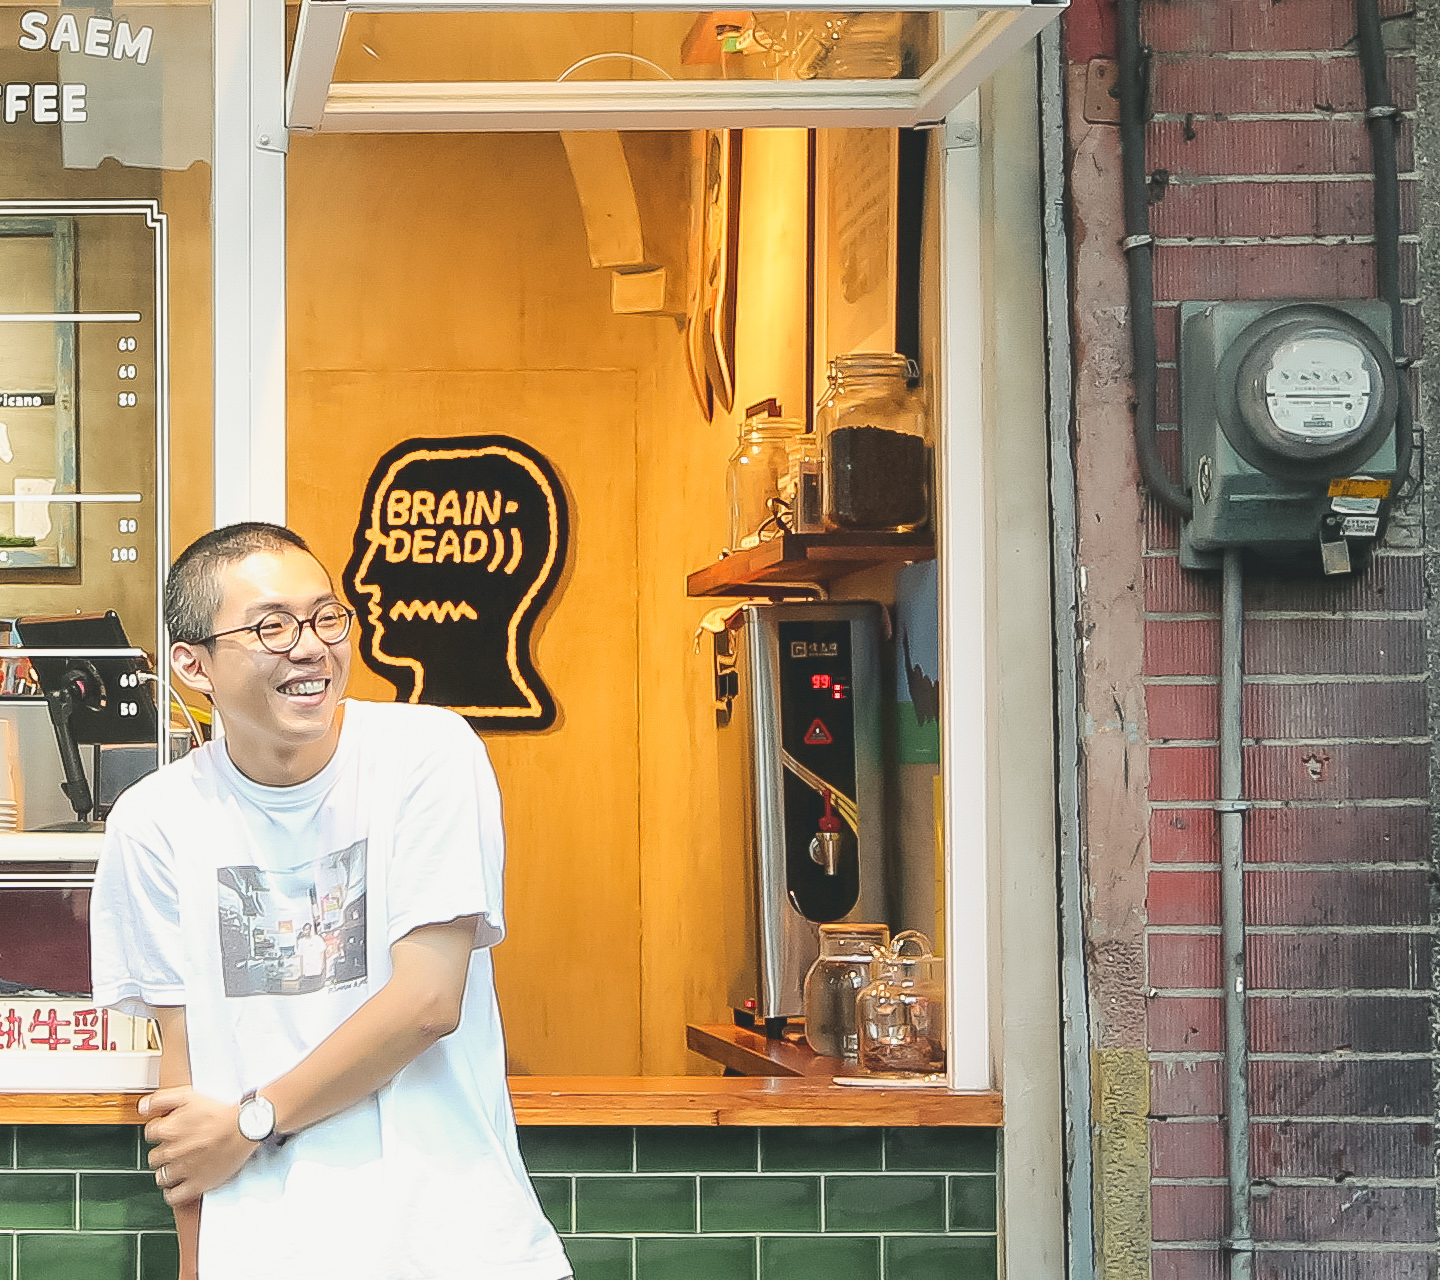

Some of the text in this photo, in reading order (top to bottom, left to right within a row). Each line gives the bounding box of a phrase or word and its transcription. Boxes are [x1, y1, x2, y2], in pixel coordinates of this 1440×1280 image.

[18, 11, 154, 65] SAEM
[118, 337, 137, 351] 60
[118, 365, 137, 380] 60
[118, 393, 137, 407] 80
[111, 547, 138, 562] 100
[119, 673, 138, 688] 60
[119, 702, 138, 717] 50
